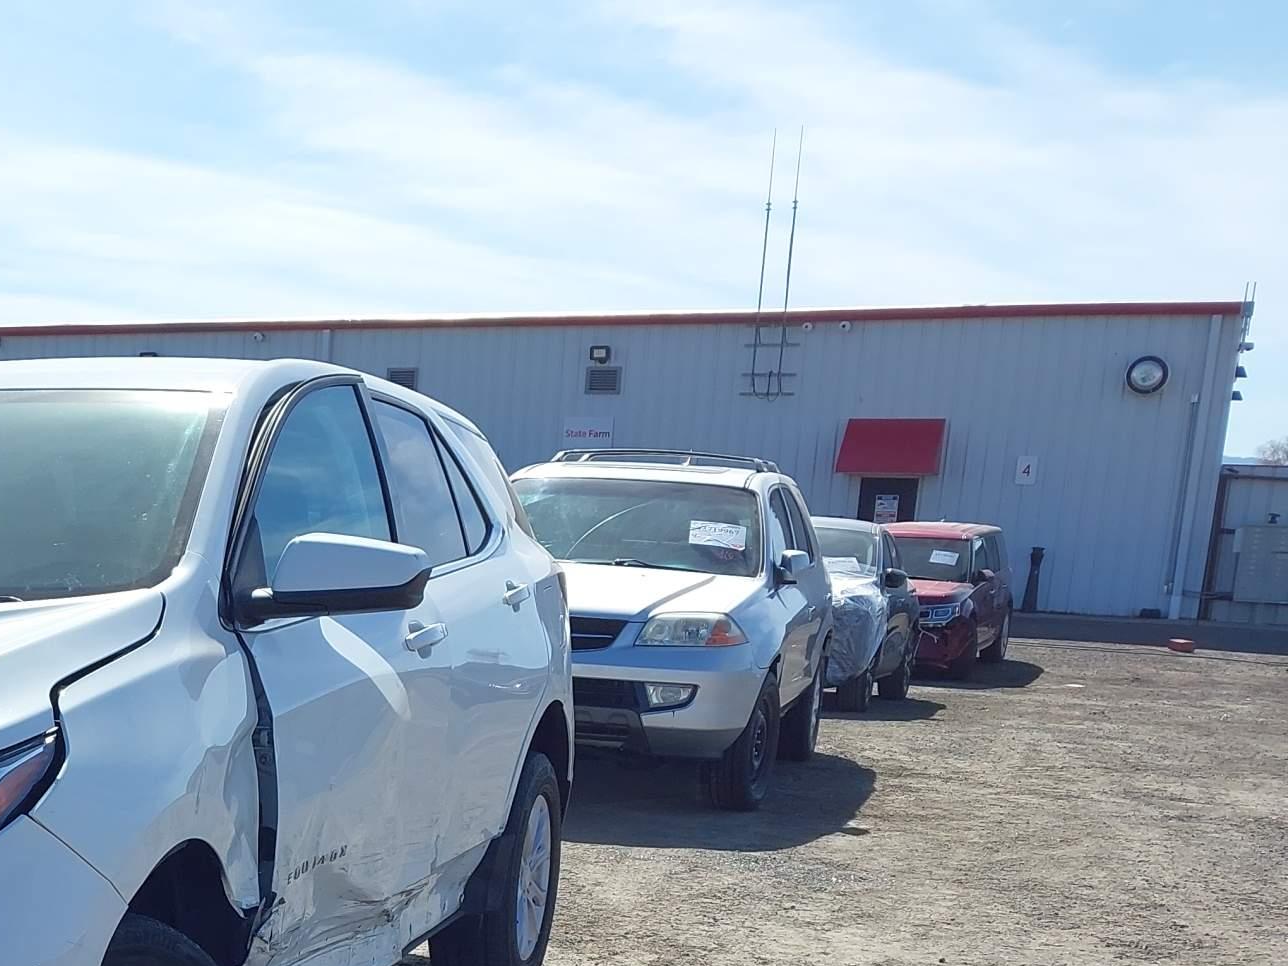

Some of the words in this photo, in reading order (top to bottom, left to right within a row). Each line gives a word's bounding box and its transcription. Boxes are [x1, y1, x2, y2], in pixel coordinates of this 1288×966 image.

[566, 429, 587, 438] State
[589, 429, 610, 438] Farm
[1022, 463, 1031, 477] 4
